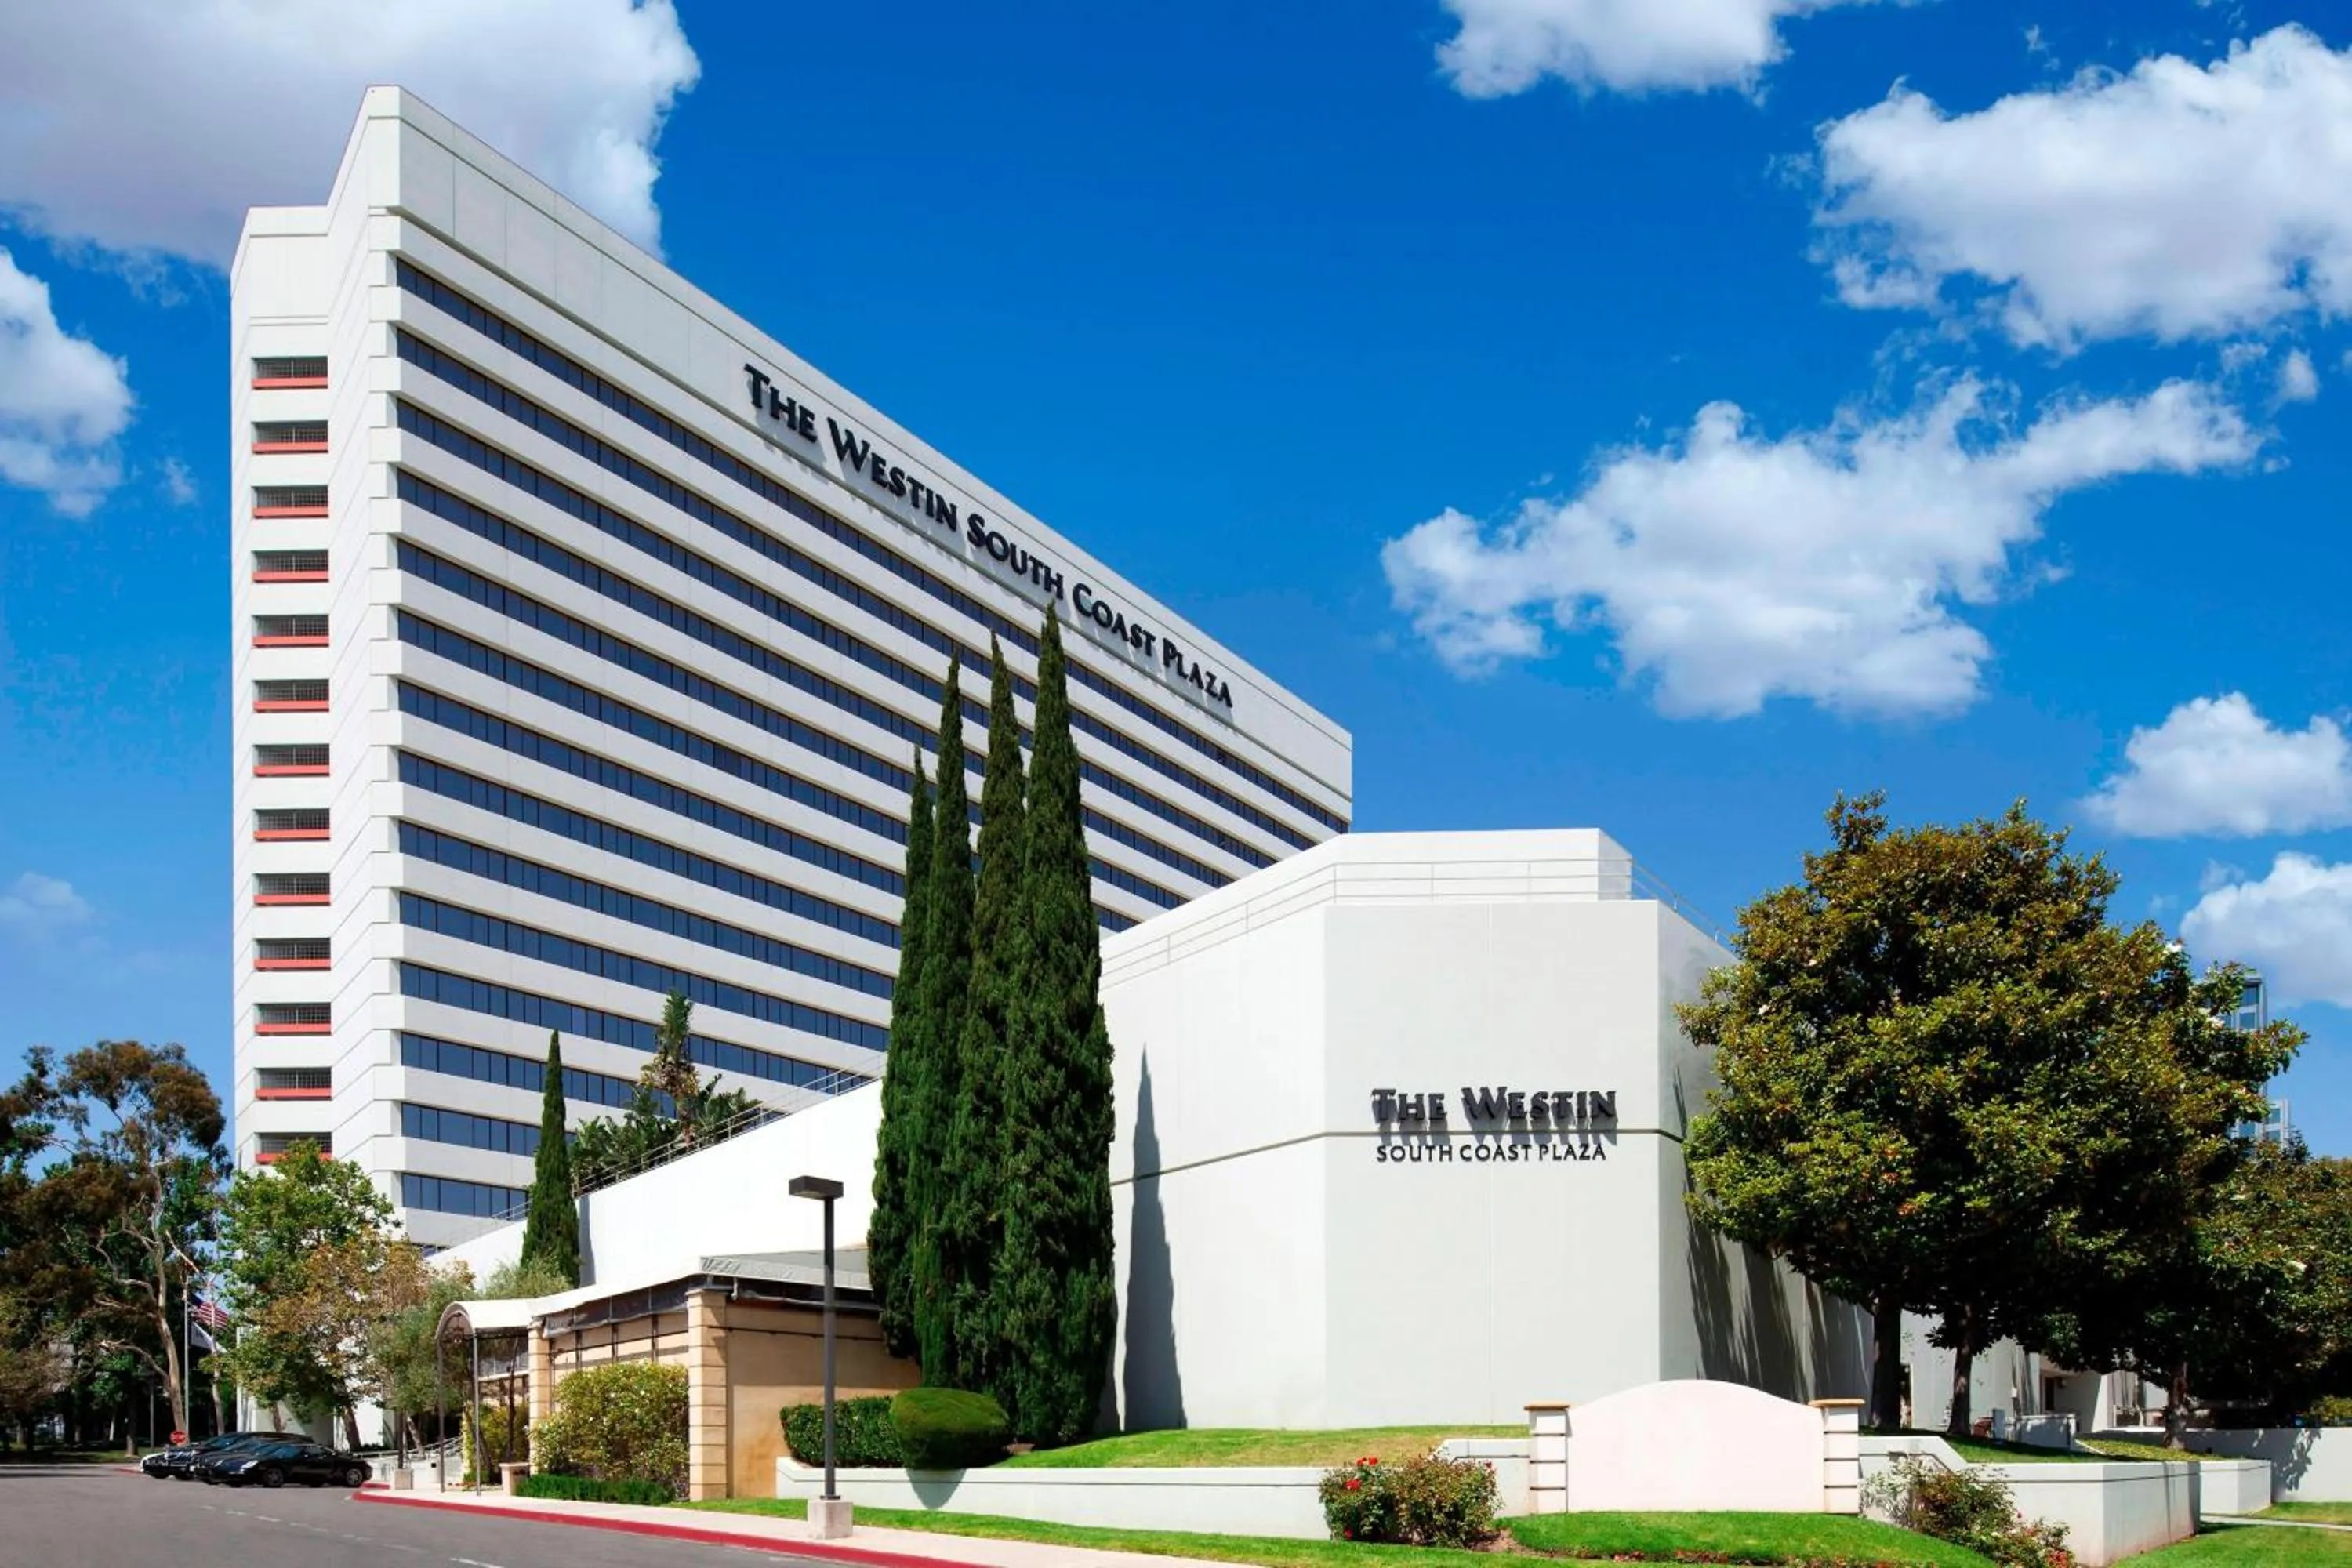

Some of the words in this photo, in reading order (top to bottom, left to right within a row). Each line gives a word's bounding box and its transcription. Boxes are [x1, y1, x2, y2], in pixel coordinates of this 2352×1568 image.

[744, 364, 817, 443] THE
[827, 417, 957, 532] WESTIN
[967, 513, 1064, 601] SOUTH
[1073, 583, 1156, 657] COAST
[1163, 637, 1233, 708] PLAZA
[1372, 1088, 1447, 1121] THE
[1461, 1087, 1617, 1120] WESTIN
[1377, 1145, 1452, 1162] SOUTH
[1460, 1145, 1531, 1161] COAST
[1539, 1143, 1606, 1160] PLAZA
